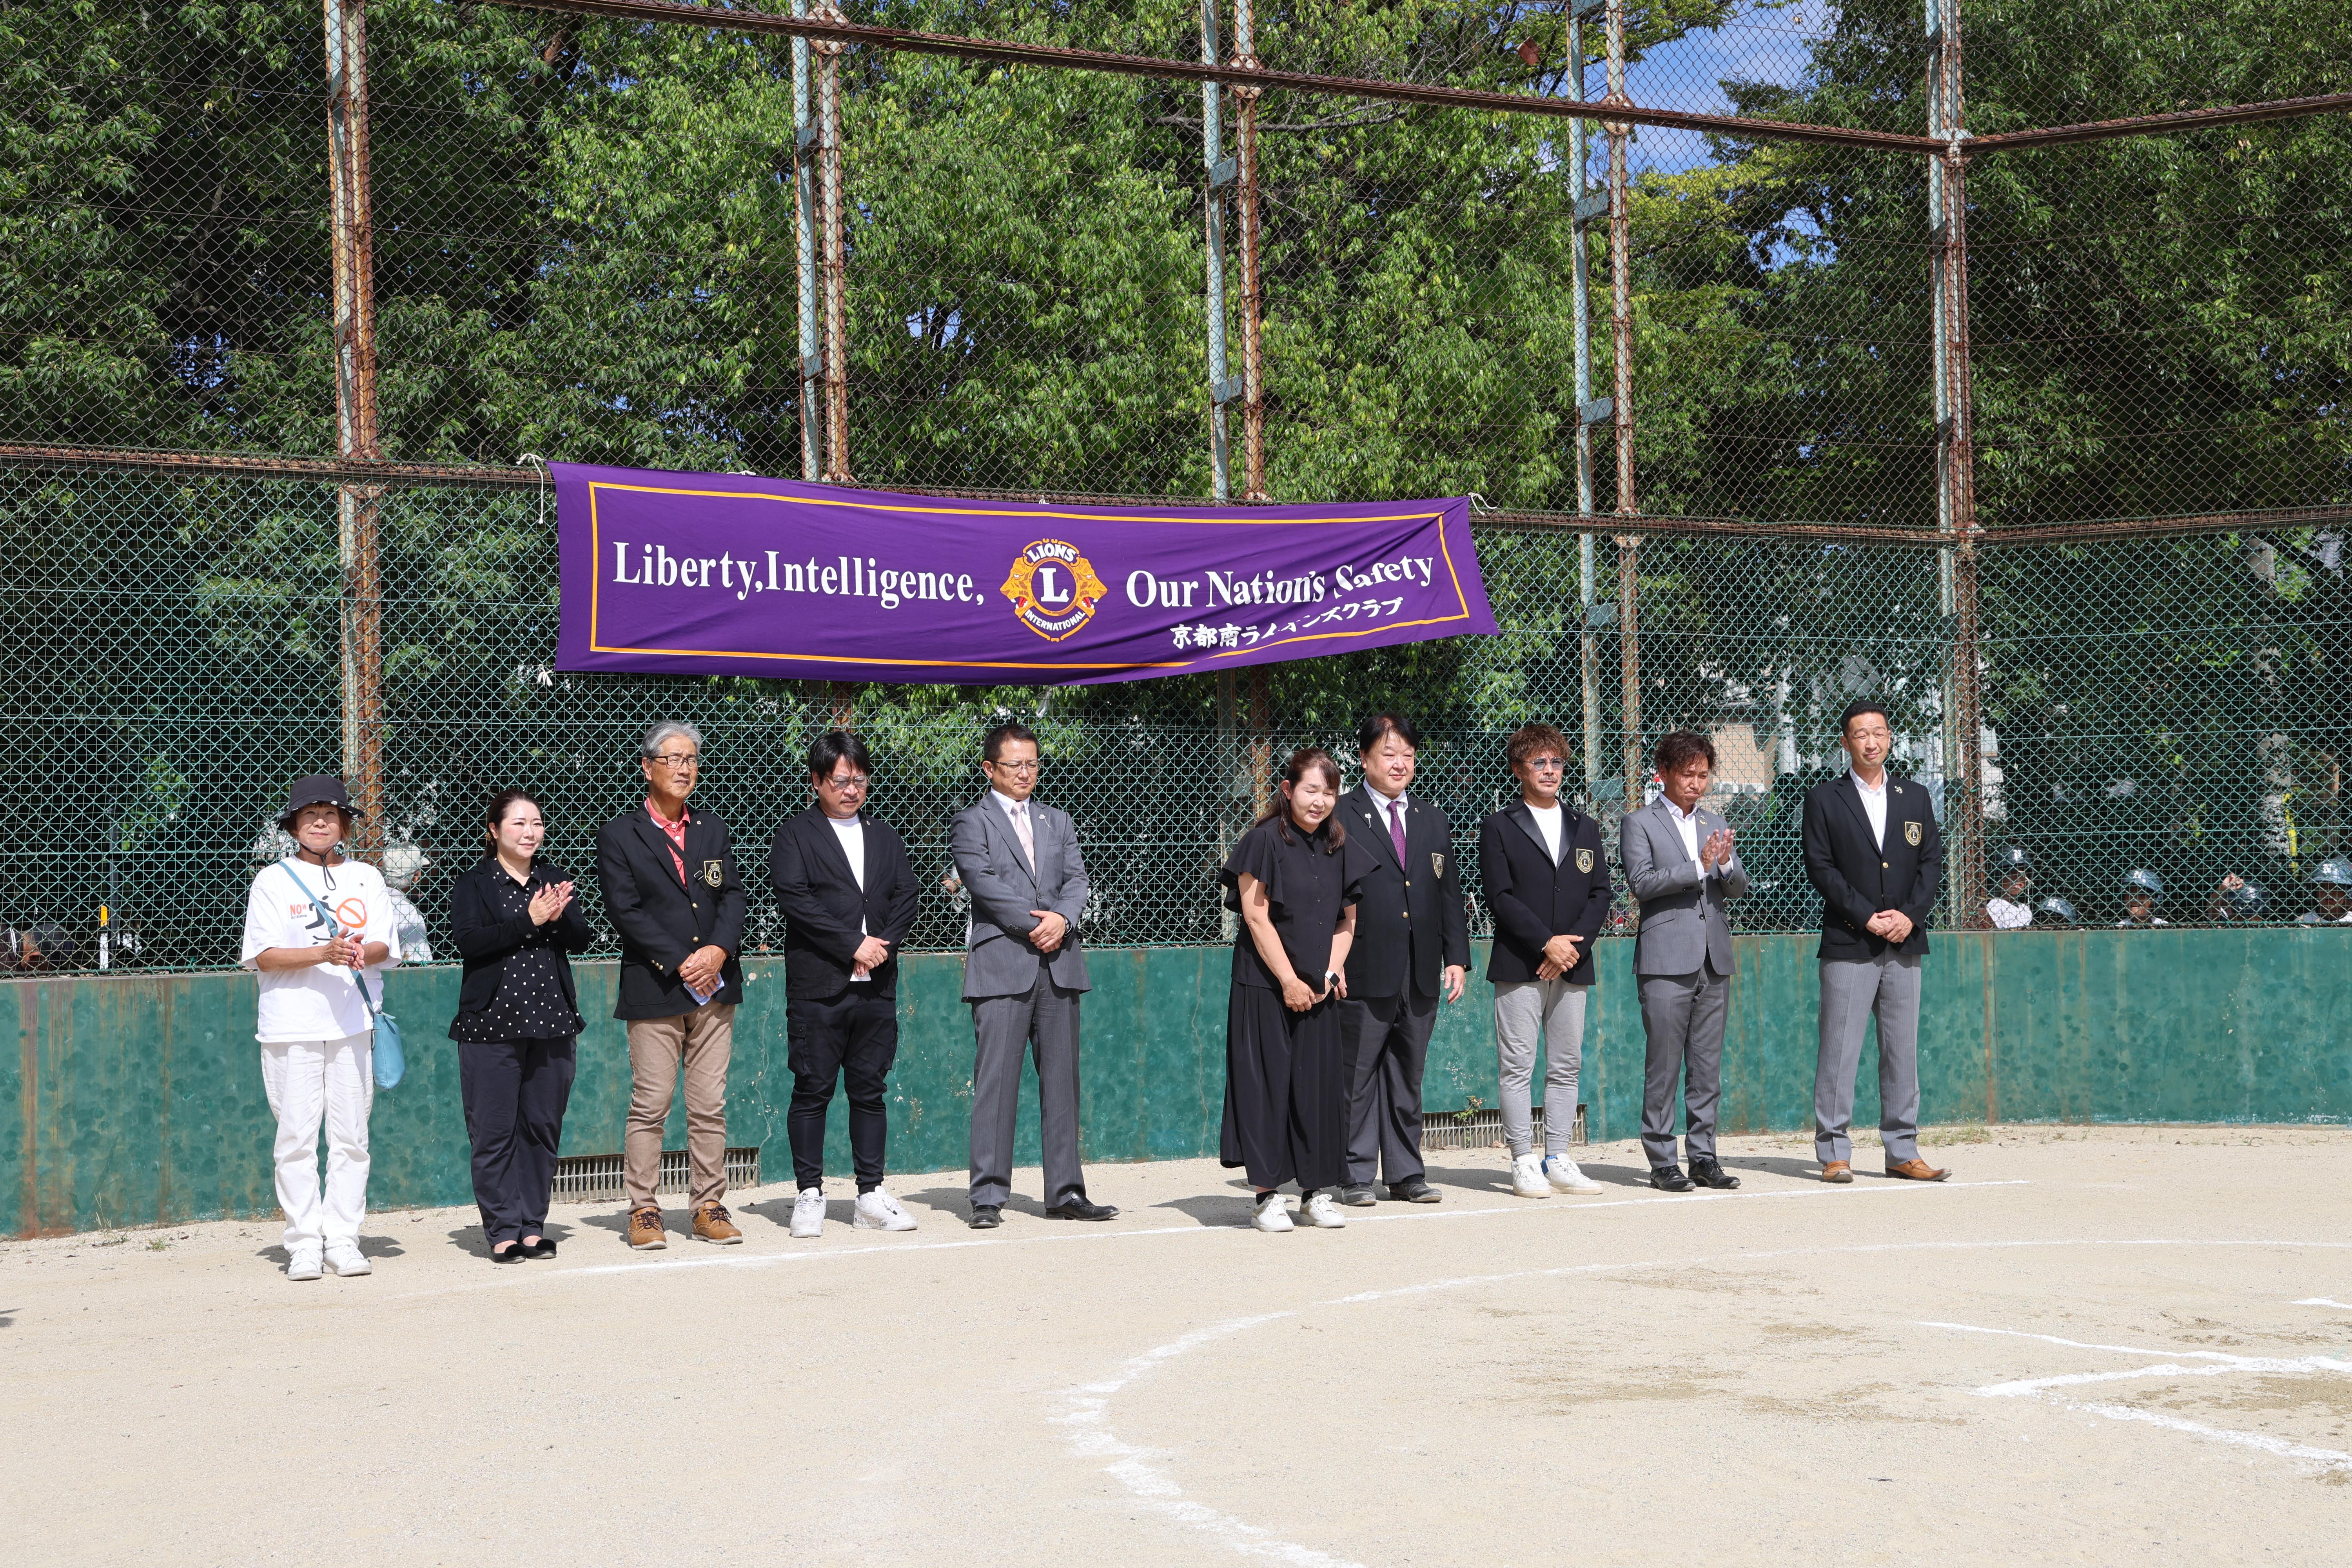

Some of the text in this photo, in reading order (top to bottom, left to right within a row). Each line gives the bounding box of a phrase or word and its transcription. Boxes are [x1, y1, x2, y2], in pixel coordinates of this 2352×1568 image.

[1026, 543, 1076, 562] LIONS
[1039, 568, 1069, 602] L
[1126, 555, 1434, 608] Our Nation's Safety
[1024, 609, 1086, 631] INTERNATIONAL
